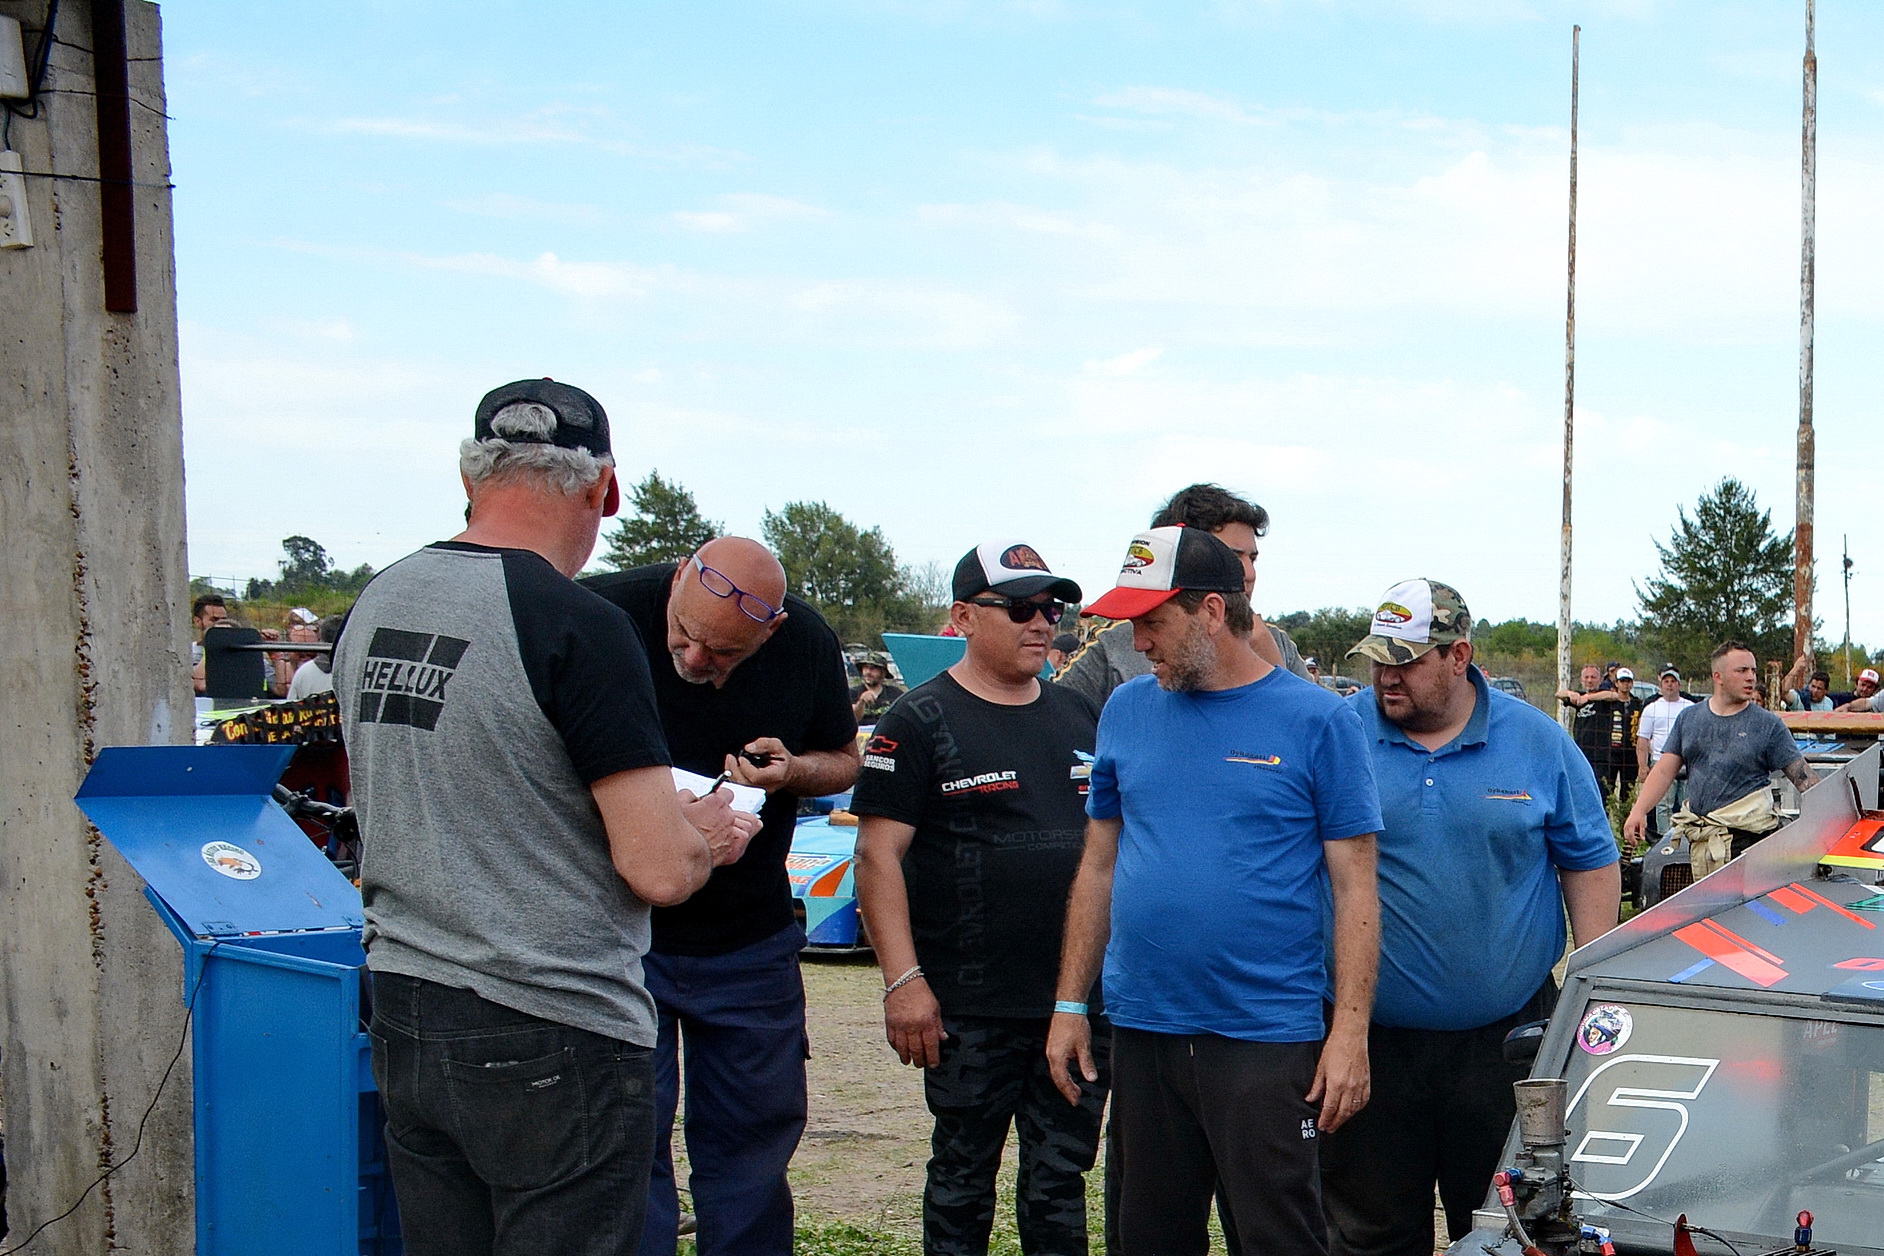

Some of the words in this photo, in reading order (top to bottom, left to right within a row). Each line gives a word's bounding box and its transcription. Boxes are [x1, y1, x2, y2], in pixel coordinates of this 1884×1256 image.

[362, 661, 454, 701] HELLUX
[863, 761, 895, 772] SEGUROS
[865, 754, 896, 766] SANCOR
[942, 771, 1017, 792] CHEVROLET
[978, 780, 1019, 794] RACING
[1565, 1054, 1721, 1201] 6
